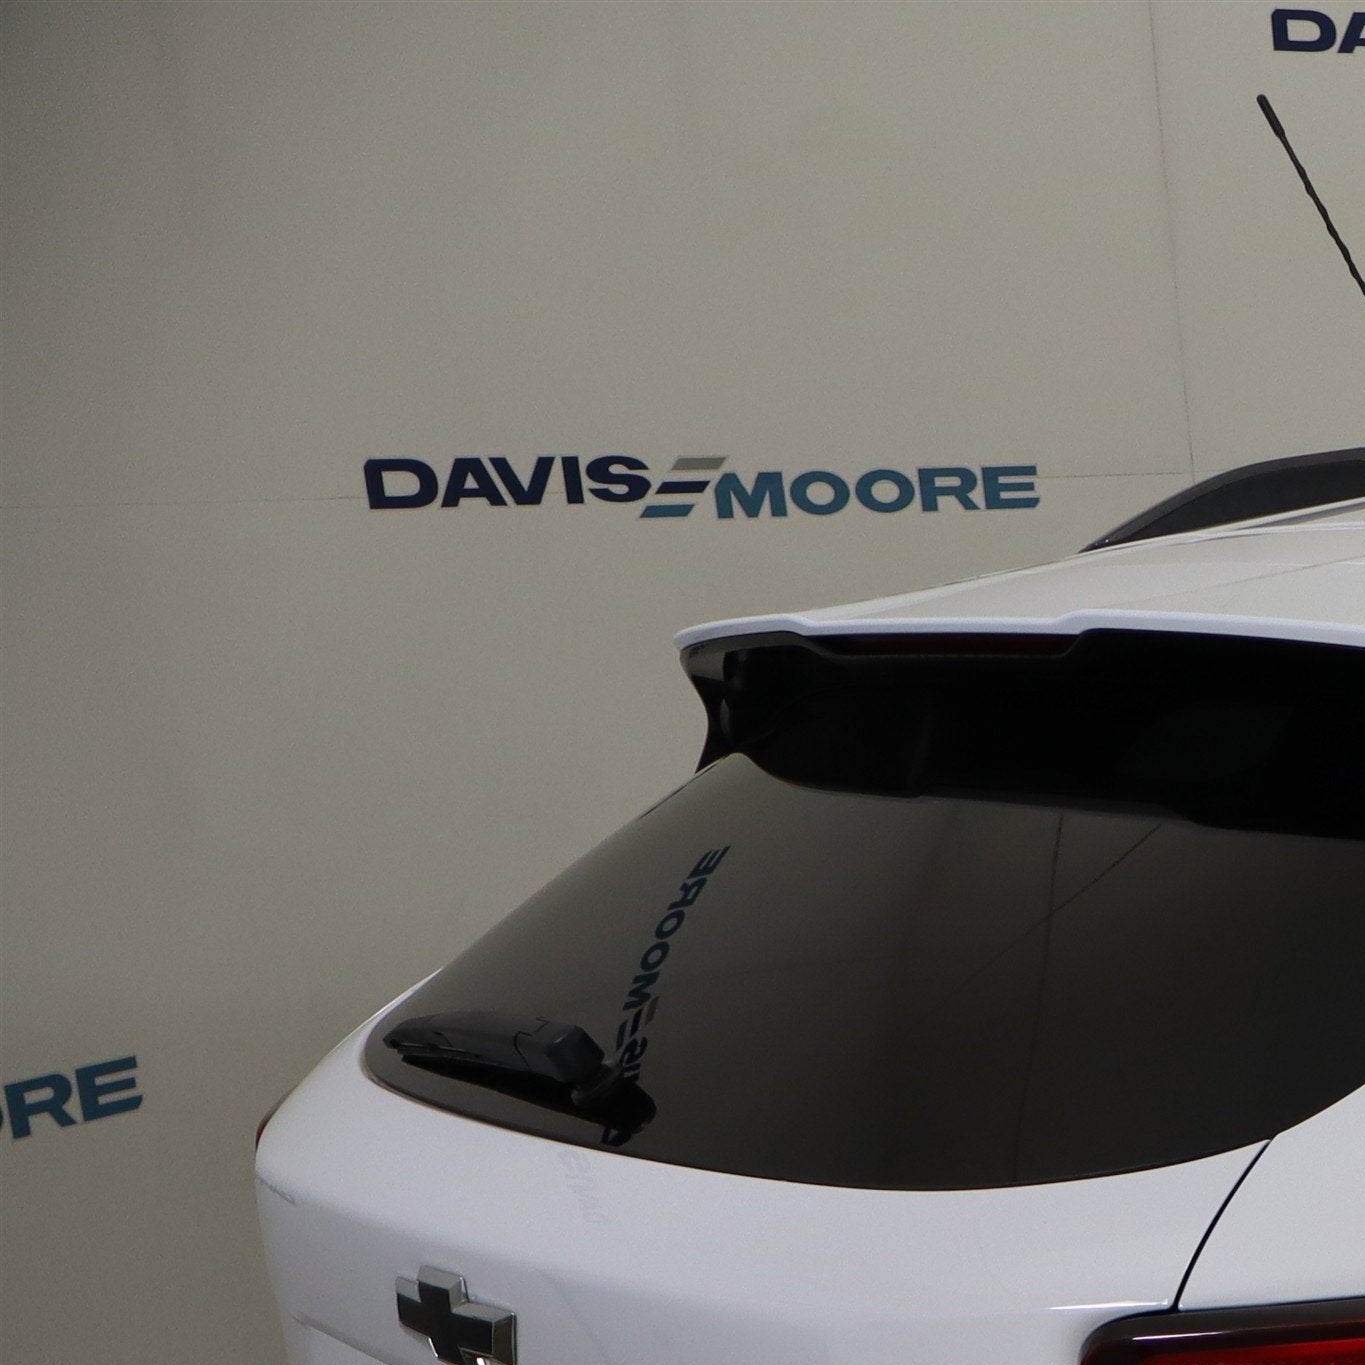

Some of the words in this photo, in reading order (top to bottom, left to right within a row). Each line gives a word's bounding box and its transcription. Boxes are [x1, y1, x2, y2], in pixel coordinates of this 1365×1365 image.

[363, 455, 652, 510] DAVIS
[715, 465, 1041, 520] MOORE
[0, 1055, 144, 1140] RE
